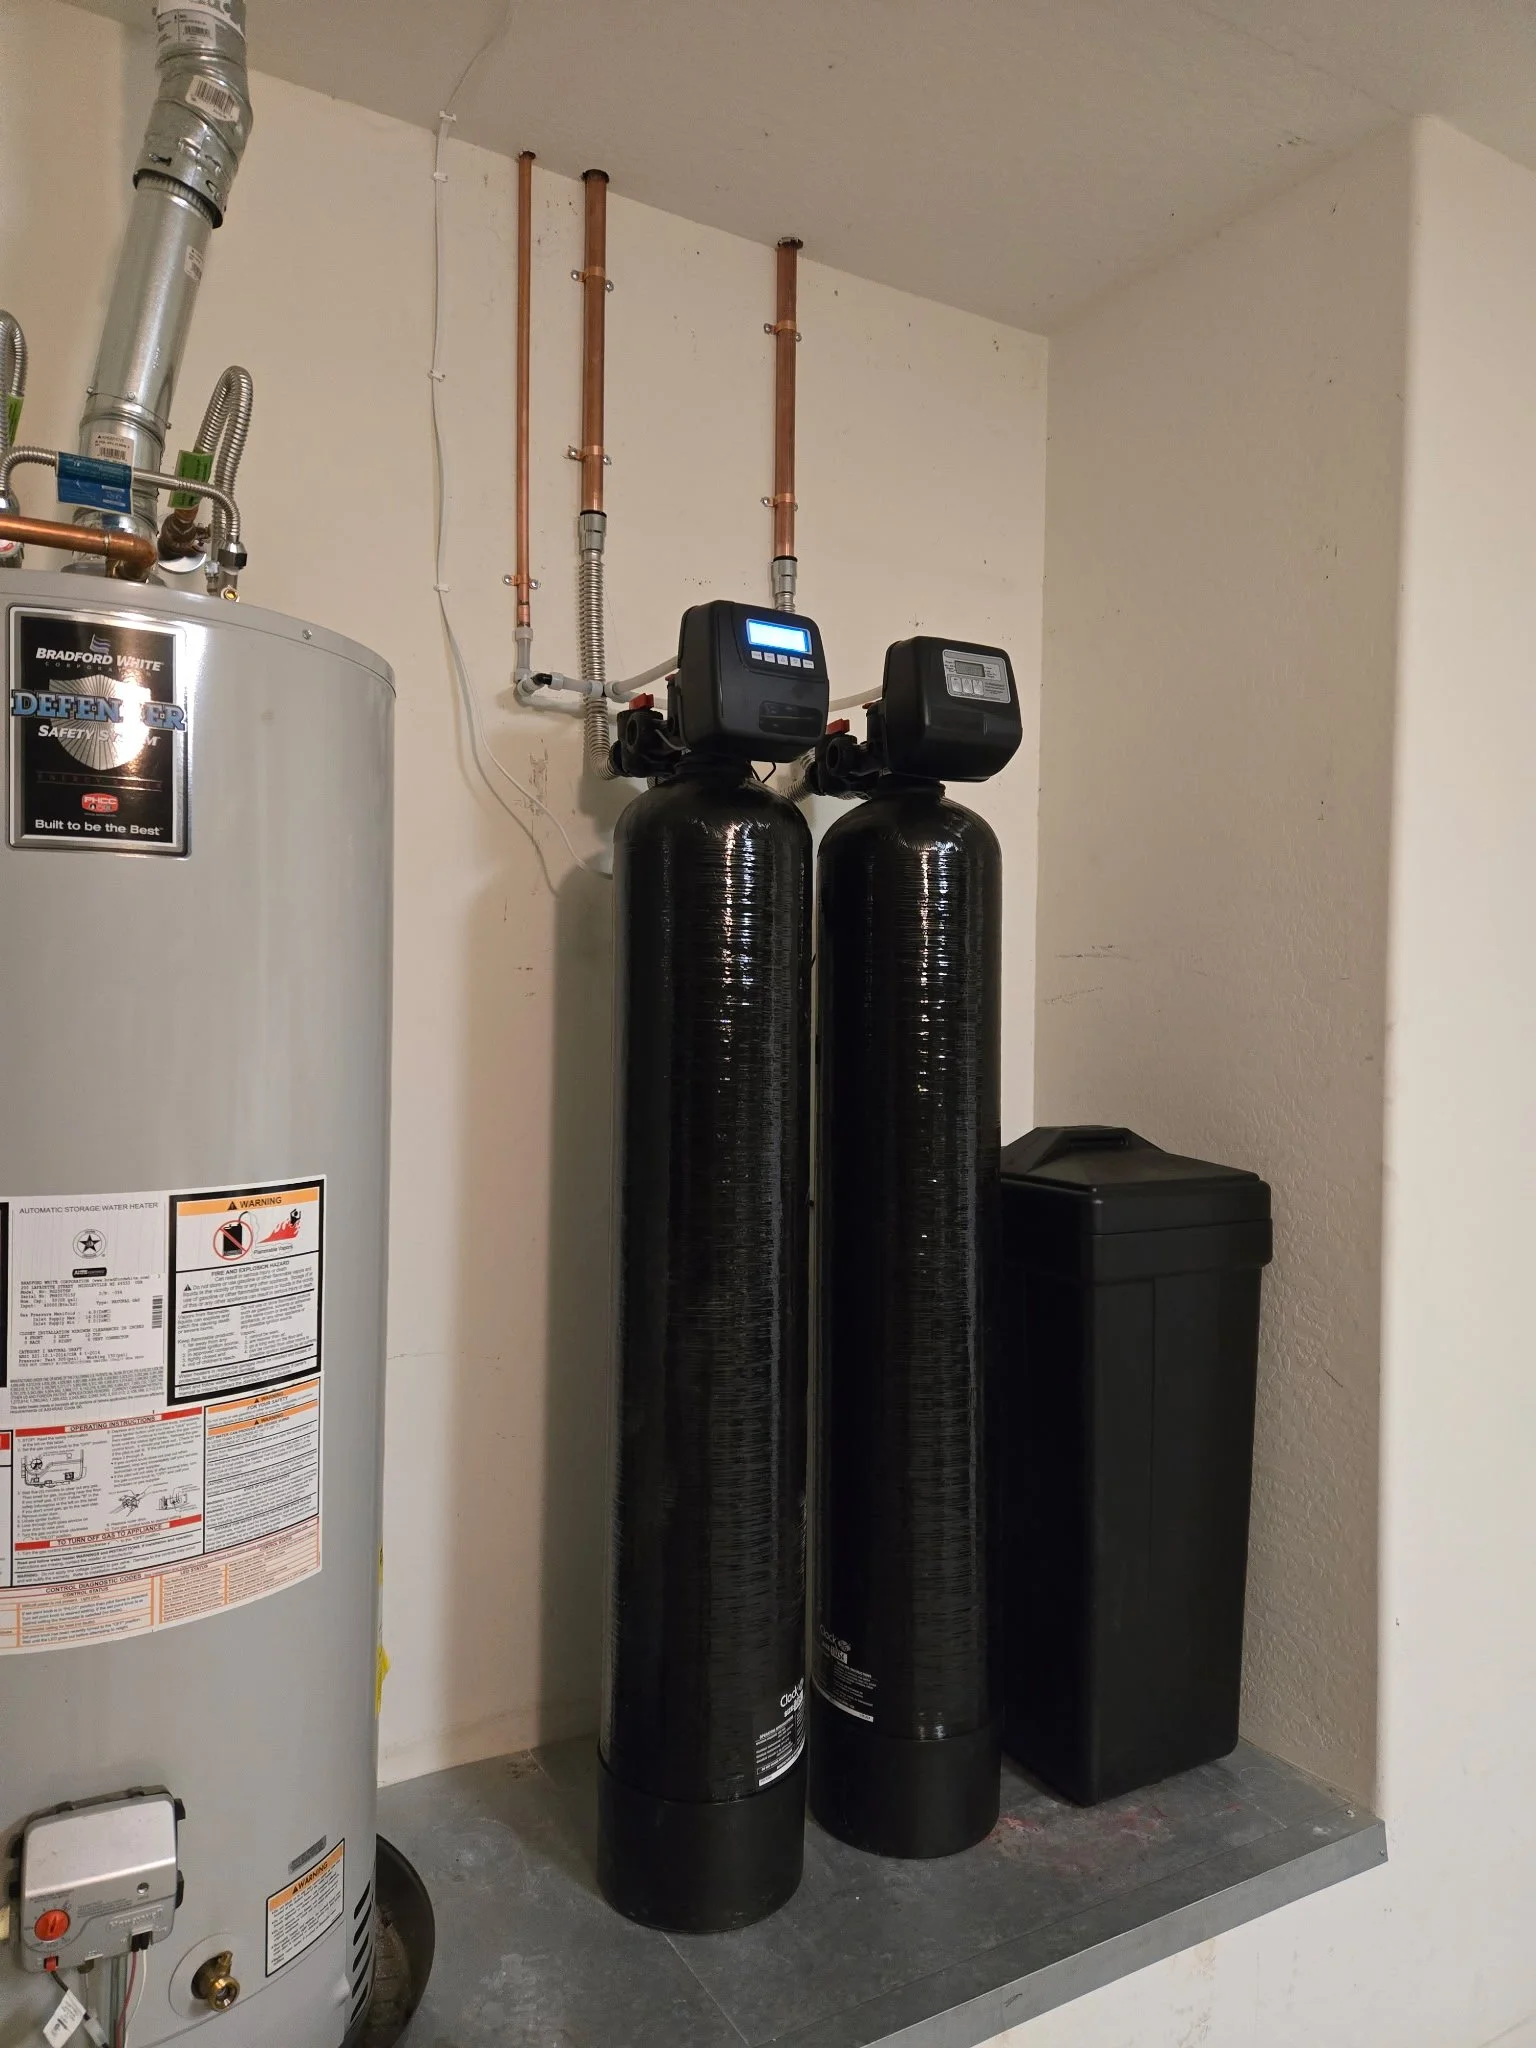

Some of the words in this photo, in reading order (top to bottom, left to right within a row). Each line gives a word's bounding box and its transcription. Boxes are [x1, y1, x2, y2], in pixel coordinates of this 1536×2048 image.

[35, 647, 113, 665] BRADFORD
[116, 655, 161, 672] WHITE
[11, 690, 186, 732] DEFENER
[38, 725, 95, 741] SAFETY
[35, 819, 64, 830] Built
[67, 821, 81, 831] to
[84, 821, 102, 832] be
[105, 823, 126, 833] the
[130, 825, 160, 836] Best
[64, 1205, 100, 1213] STORAGE
[129, 1202, 159, 1210] HEATER
[240, 1197, 282, 1208] WARNING
[270, 1260, 290, 1268] HAZARD
[70, 1423, 108, 1432] OPERATING
[108, 1416, 156, 1428] INSTRUCTIONS
[68, 1537, 85, 1545] TURN
[102, 1532, 116, 1540] GAS
[127, 1524, 162, 1536] APPLIANCE
[46, 1584, 78, 1594] CONTROL
[79, 1578, 119, 1590] DIAGNOSTIC
[119, 1573, 142, 1583] CODES
[298, 1861, 328, 1890] WARNING
